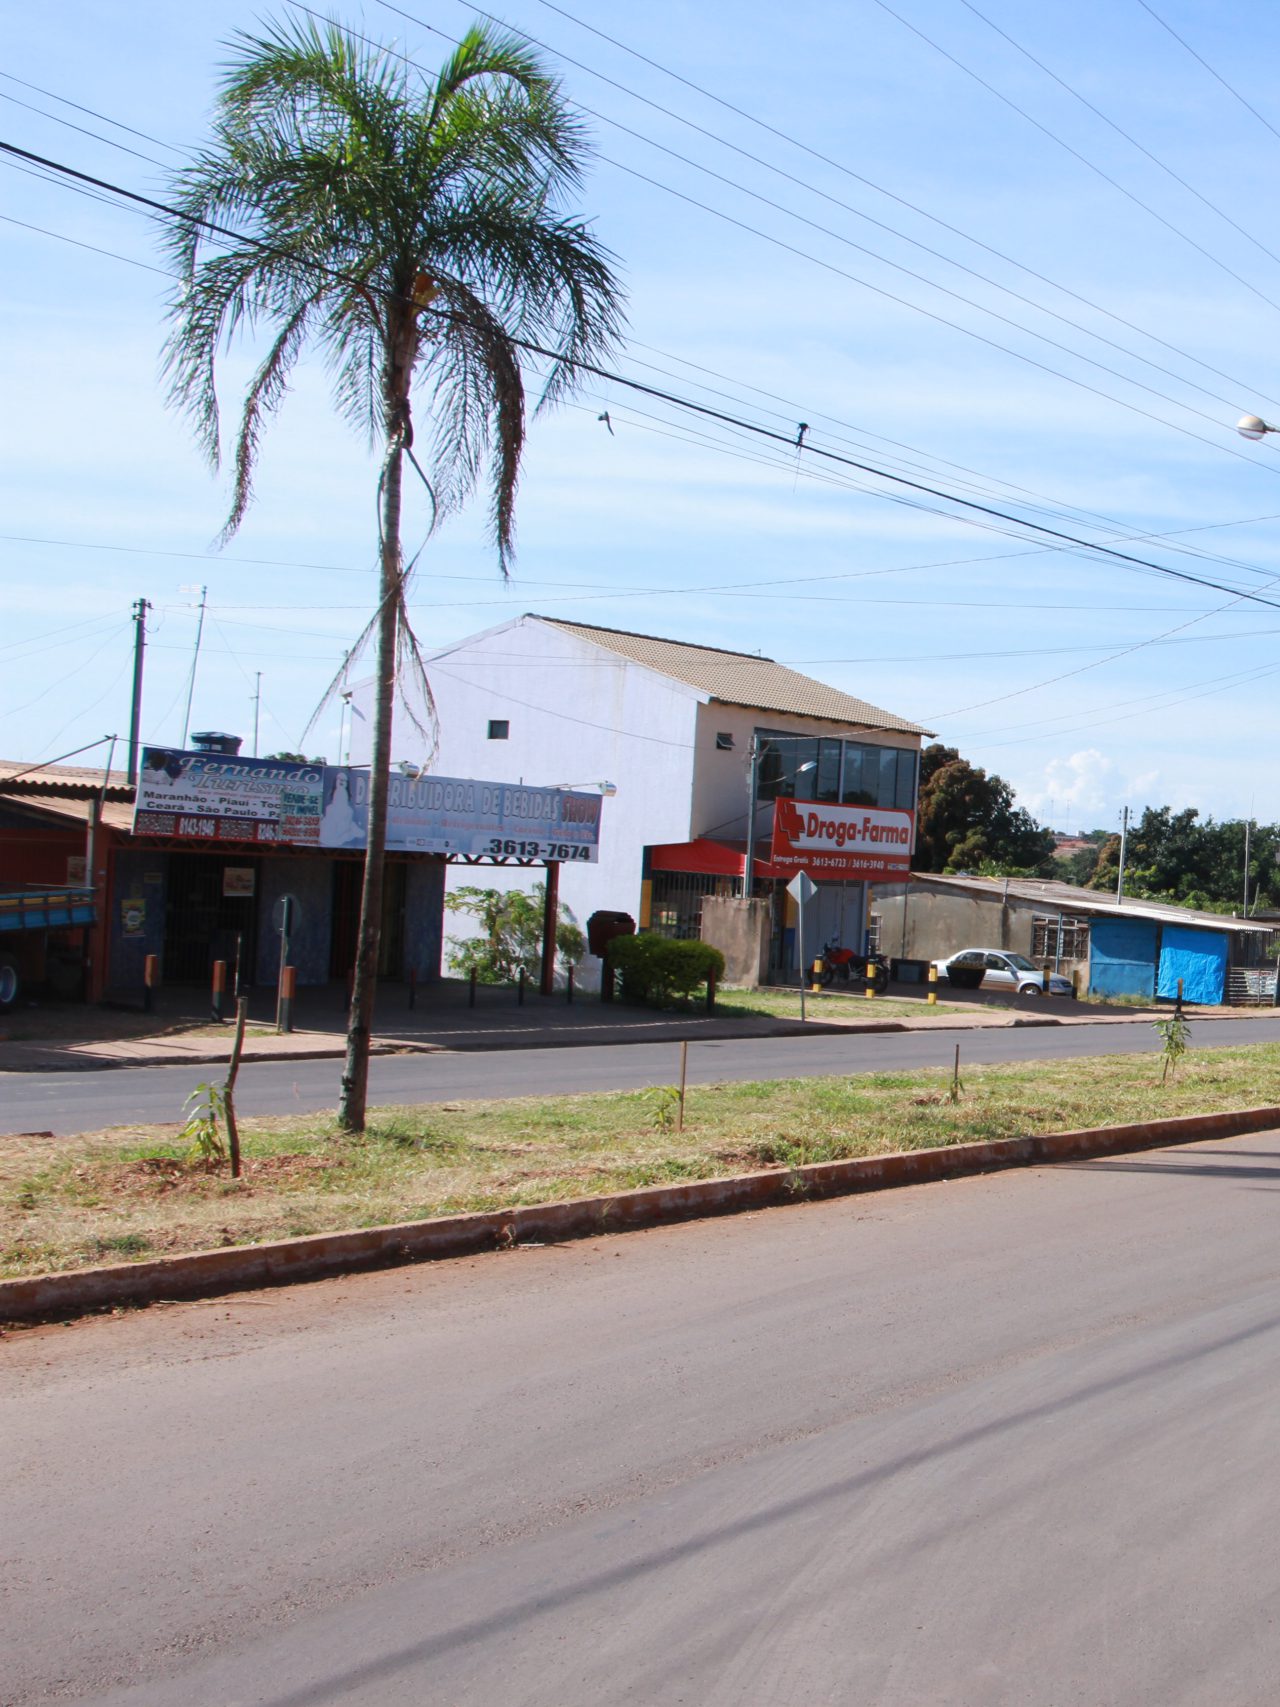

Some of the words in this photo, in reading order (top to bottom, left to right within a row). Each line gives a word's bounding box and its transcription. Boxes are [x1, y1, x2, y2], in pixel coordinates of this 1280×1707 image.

[179, 756, 320, 784] Fernando
[143, 790, 208, 803] Maranhão
[482, 787, 500, 816] DE
[502, 788, 561, 821] BEBIDAS
[146, 801, 185, 811] Ceará
[196, 804, 220, 814] São
[224, 807, 258, 817] Paulo
[806, 812, 909, 847] Droga-Farma
[489, 838, 590, 860] 3613-7674
[812, 856, 847, 868] 3613-6723
